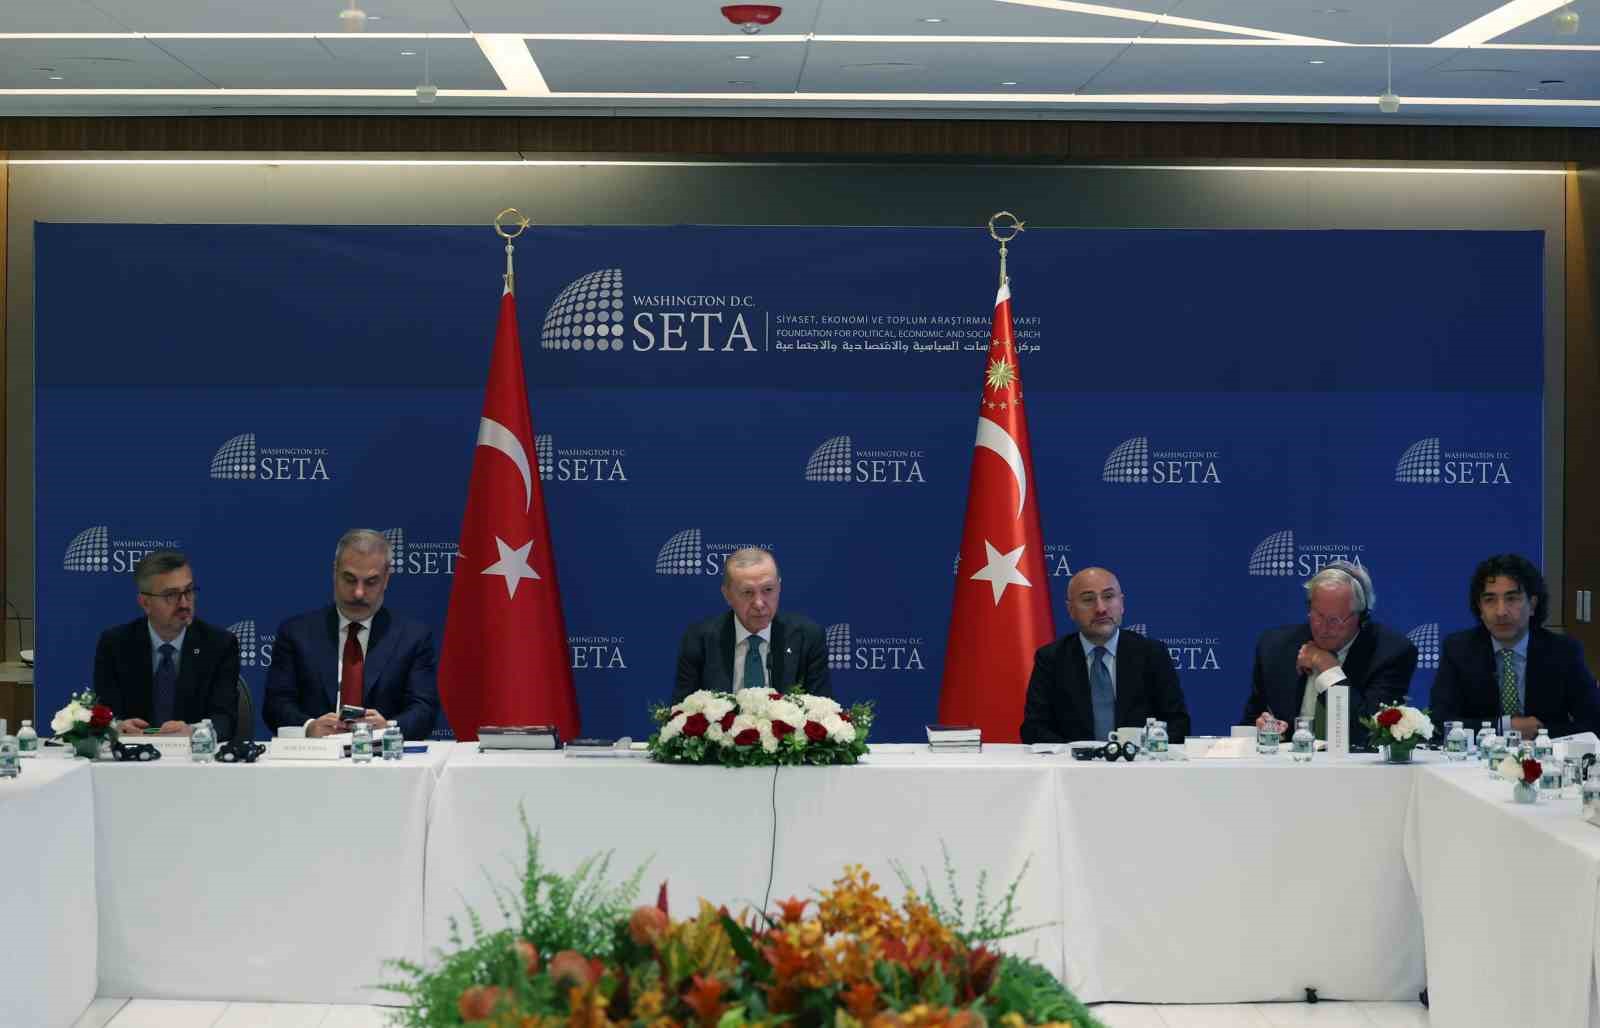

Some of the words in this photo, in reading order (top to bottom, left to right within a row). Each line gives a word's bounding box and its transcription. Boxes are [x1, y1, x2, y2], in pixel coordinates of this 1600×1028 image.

[633, 295, 726, 306] WASHINGTON
[730, 296, 756, 307] D.C.
[632, 312, 759, 352] SETA
[871, 315, 884, 324] VE
[887, 316, 927, 324] TOPLUM
[930, 316, 992, 326] ARAŞTIRMAL
[899, 330, 945, 338] ECONOMIC
[946, 330, 964, 338] AND
[966, 330, 991, 338] SOCIA
[260, 457, 330, 480] SETA
[558, 458, 628, 481] SETA
[856, 460, 927, 482] SETA
[1152, 461, 1222, 483] SETA
[1444, 461, 1513, 484] SETA
[113, 550, 155, 573] SE
[408, 551, 458, 574] SET
[571, 646, 628, 669] ETA
[855, 647, 926, 670] SETA
[1168, 647, 1221, 670] ETA
